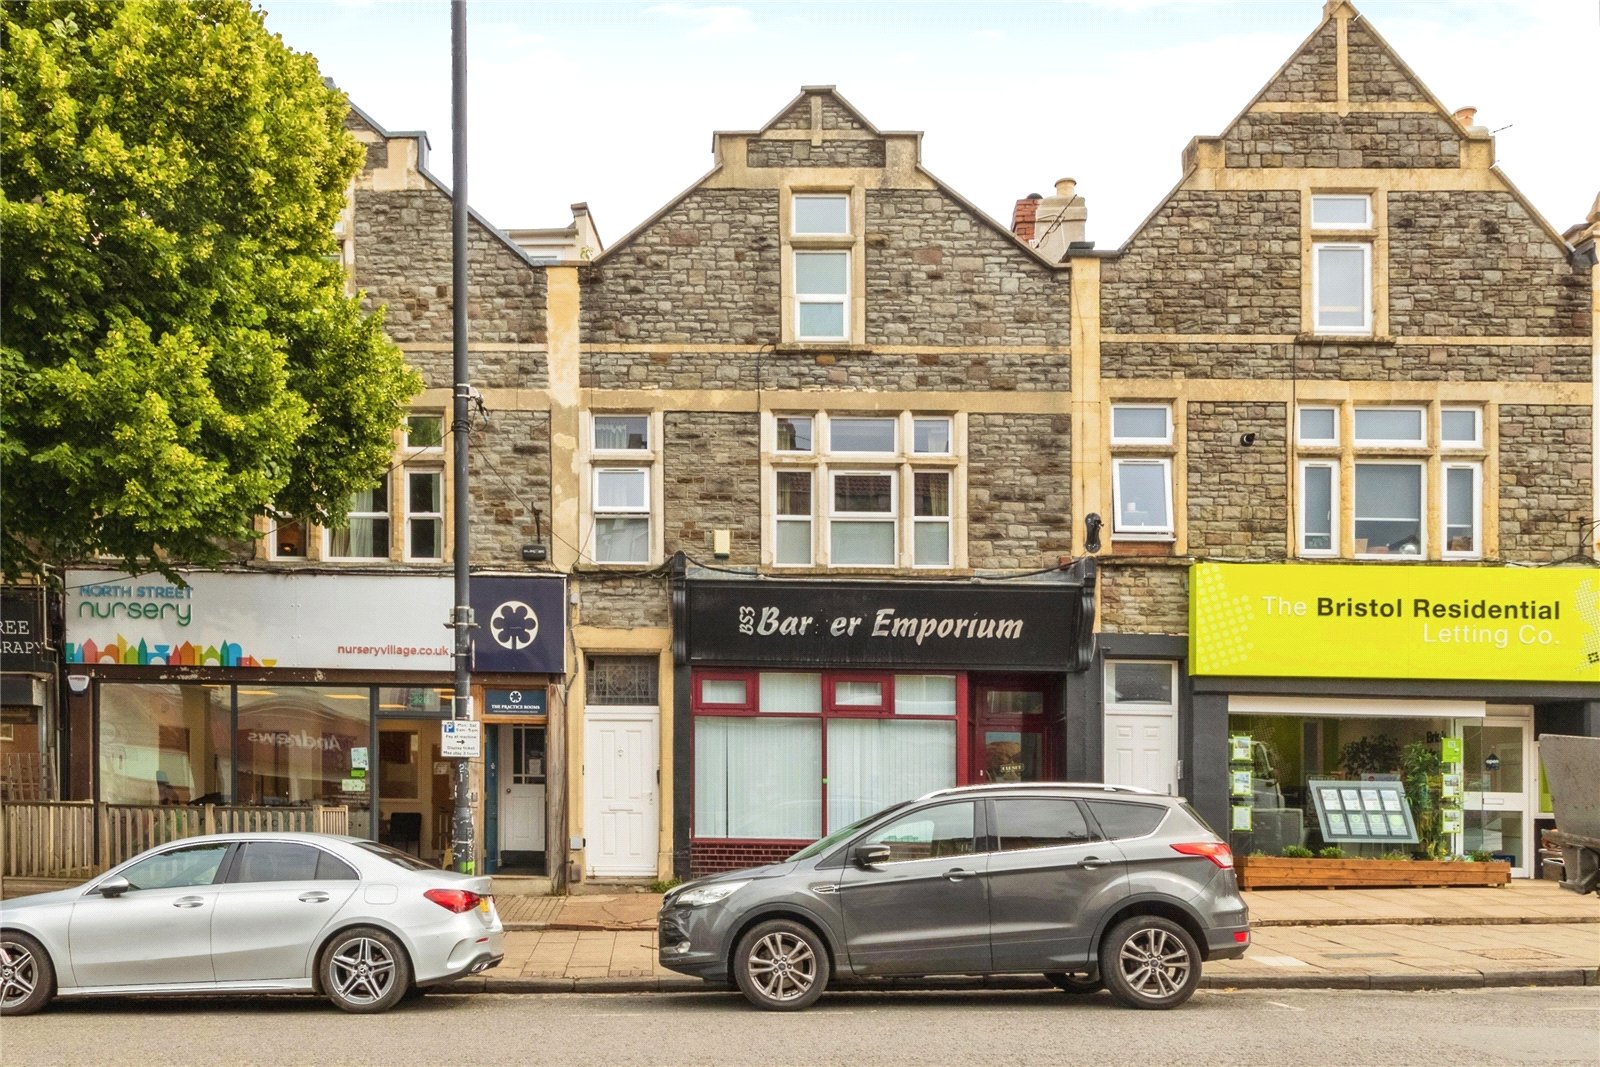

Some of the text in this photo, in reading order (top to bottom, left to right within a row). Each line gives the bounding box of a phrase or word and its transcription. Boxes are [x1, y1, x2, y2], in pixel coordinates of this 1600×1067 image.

[79, 585, 194, 599] NORTH STREET
[79, 600, 193, 627] nursery
[1261, 595, 1560, 620] The Bristol Residential
[872, 608, 1023, 645] Emporium
[1423, 623, 1561, 649] Letting Co.
[337, 644, 450, 657] nurseryvillage.co.uk
